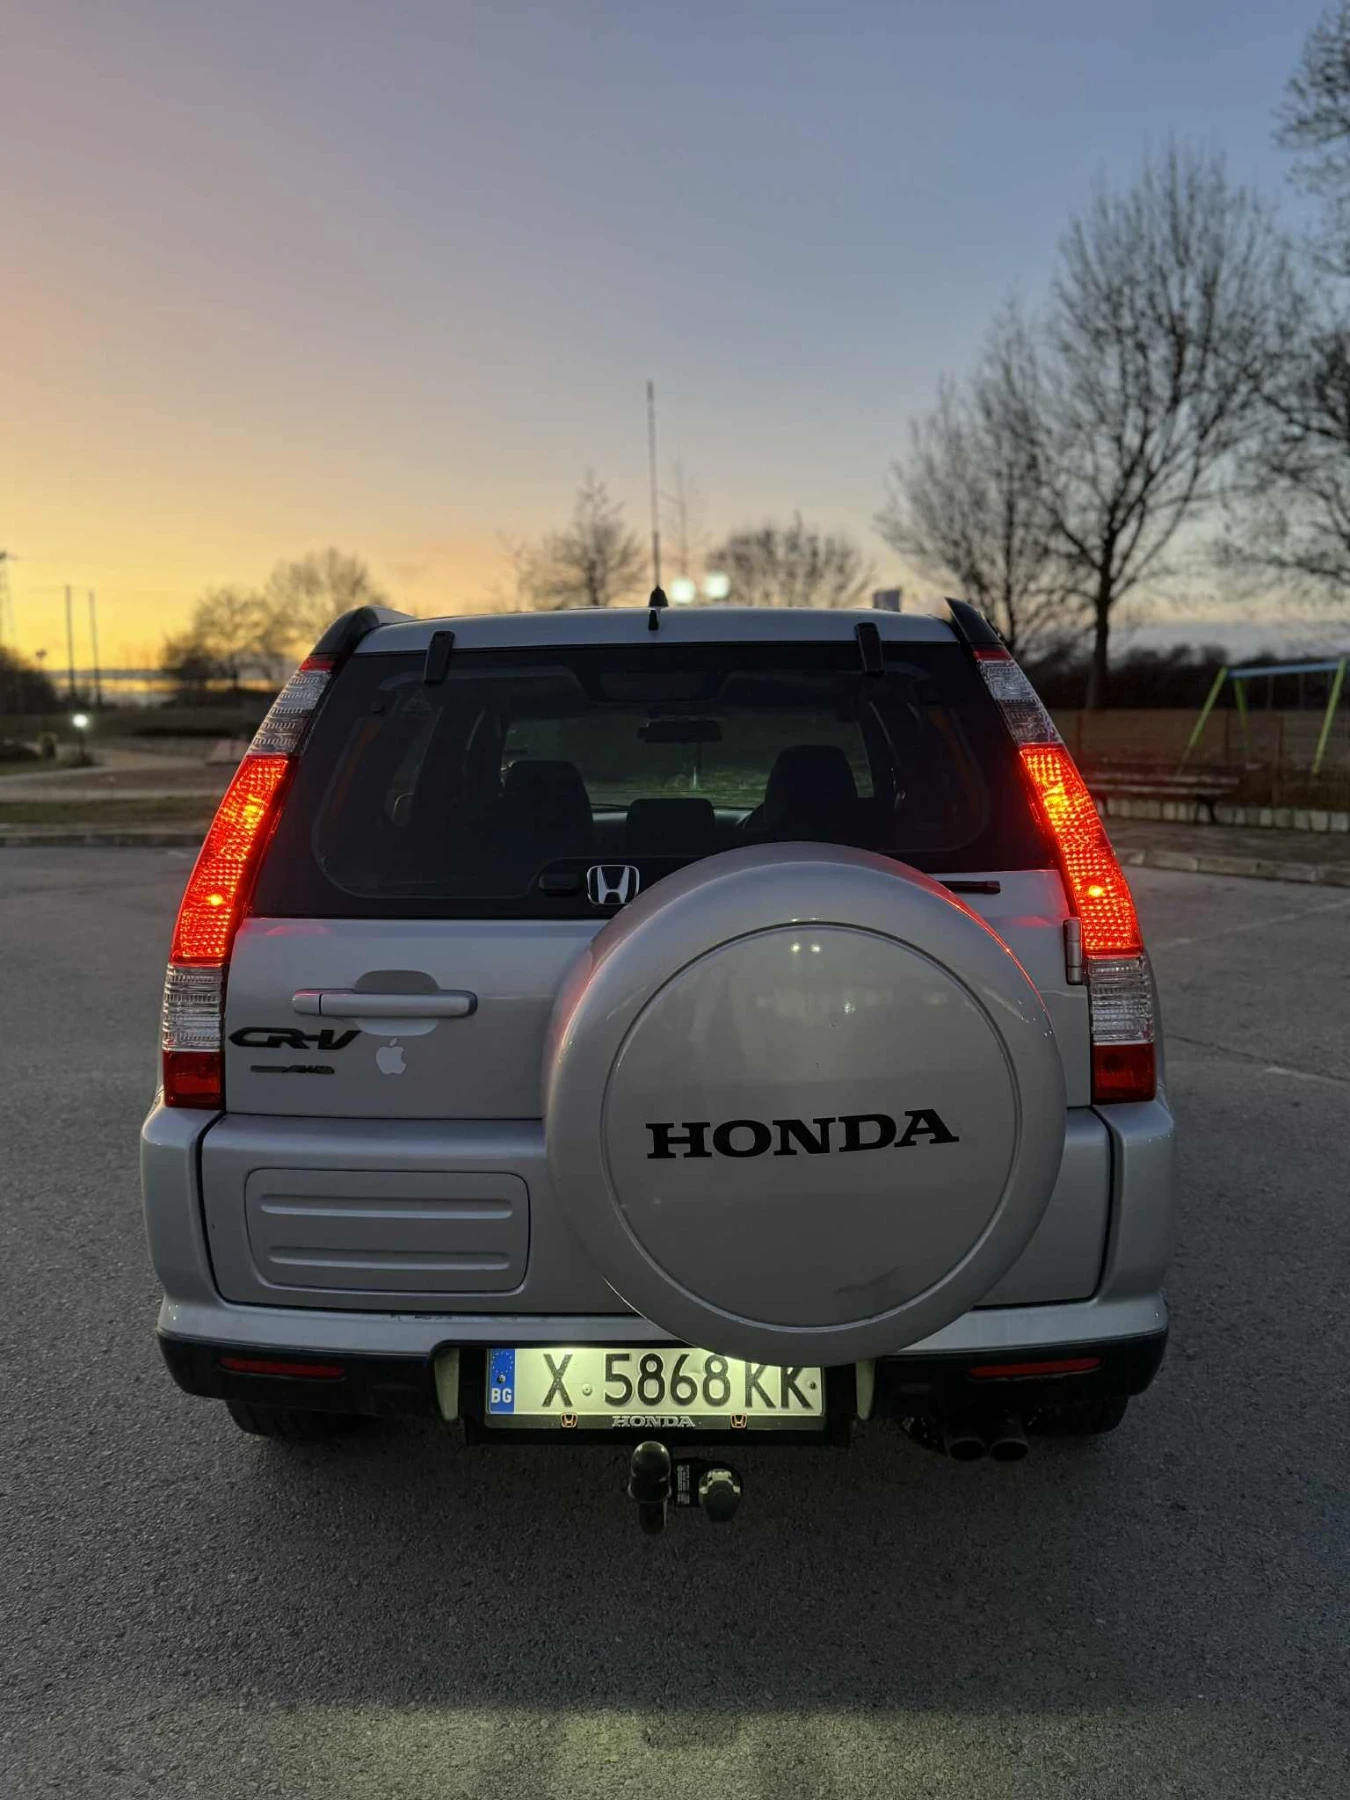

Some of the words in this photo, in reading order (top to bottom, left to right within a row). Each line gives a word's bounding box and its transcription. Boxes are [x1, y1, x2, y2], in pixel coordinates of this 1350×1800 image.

[229, 1027, 361, 1049] CR-V
[646, 1108, 960, 1159] HONDA
[542, 1353, 573, 1407] X
[604, 1353, 731, 1407] 5868
[745, 1363, 812, 1408] KK
[491, 1388, 513, 1404] BG
[611, 1416, 696, 1428] HONDA
